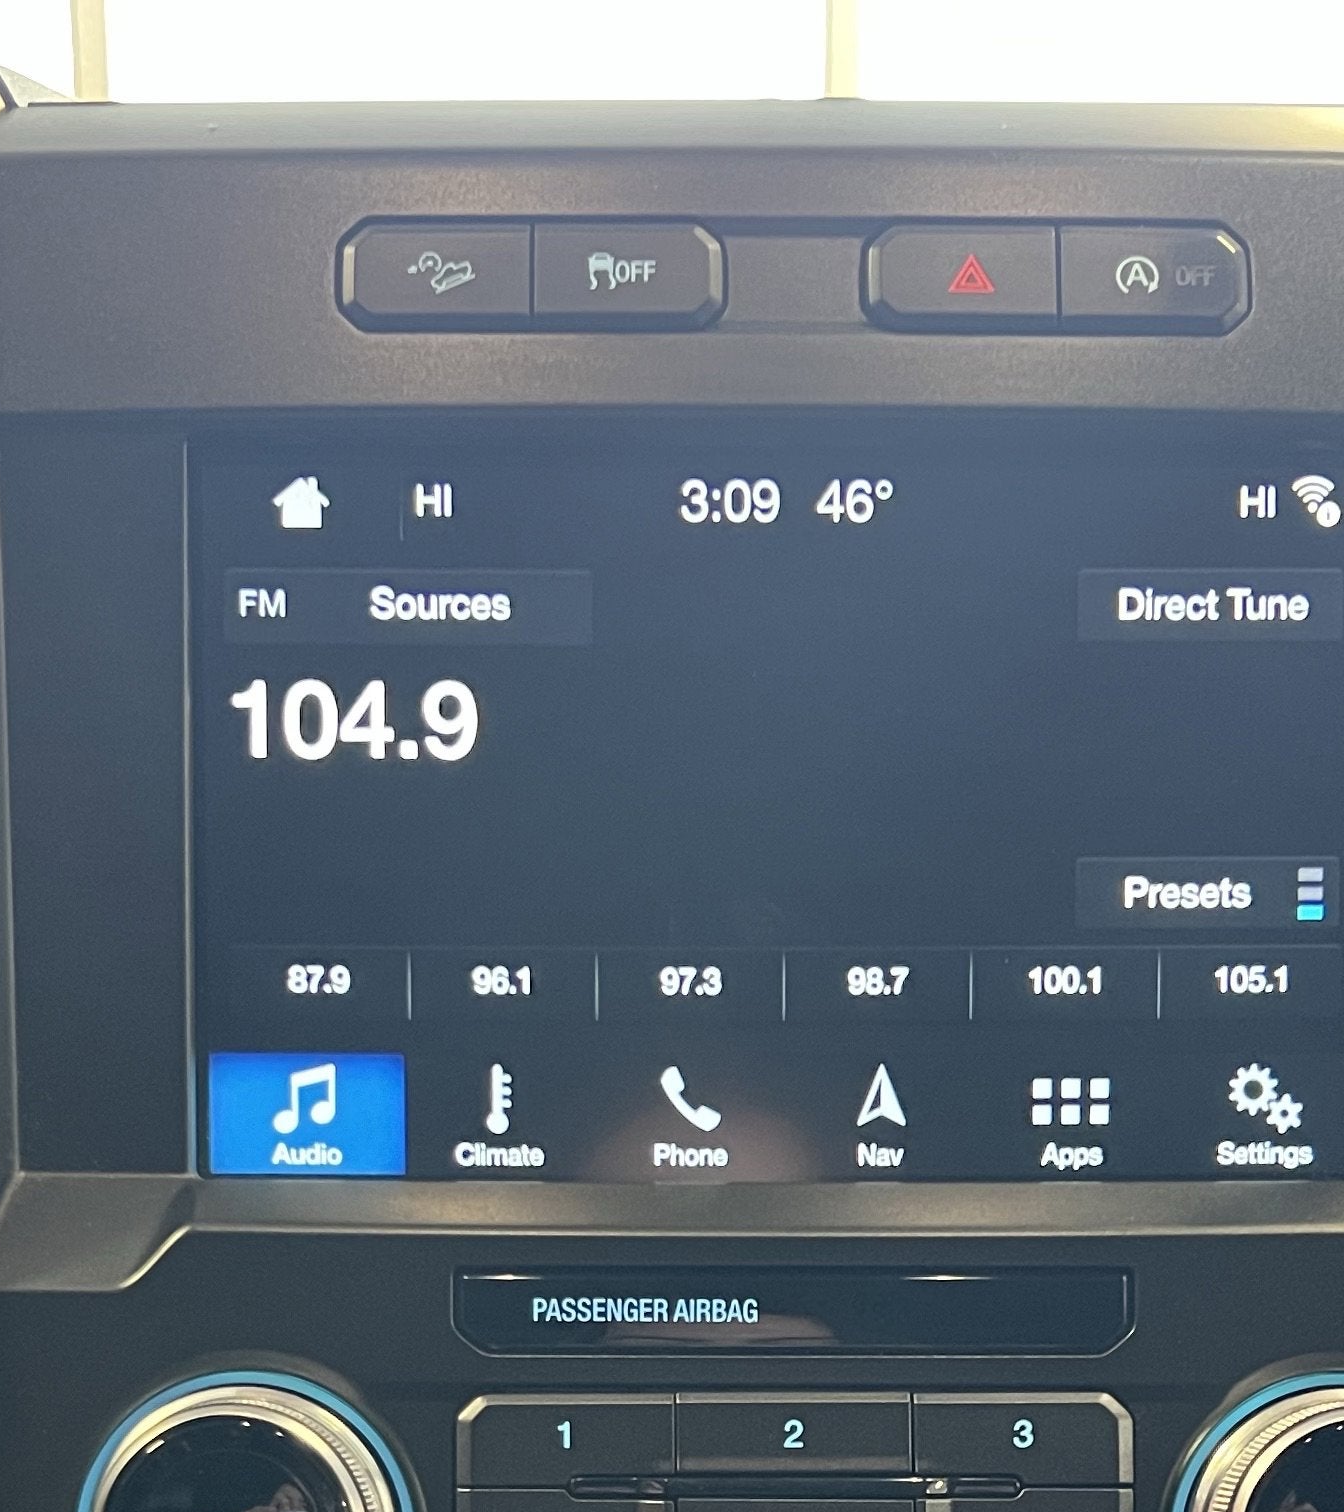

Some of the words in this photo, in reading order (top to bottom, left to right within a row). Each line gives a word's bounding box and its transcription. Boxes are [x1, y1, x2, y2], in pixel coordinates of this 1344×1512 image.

[615, 259, 656, 283] OFF
[1175, 265, 1216, 287] OFF
[415, 482, 453, 518] HI
[680, 477, 781, 524] 3:09
[816, 478, 894, 524] 46°
[1239, 484, 1277, 519] HI
[238, 587, 286, 618] FM
[369, 584, 511, 621] Sources
[1118, 586, 1220, 622] Direct
[1225, 586, 1310, 621] Tune
[230, 678, 479, 762] 104.9
[1124, 875, 1252, 910] Presets
[286, 963, 351, 995] 87.9
[471, 965, 531, 996] 96.1
[659, 965, 723, 997] 97.3
[847, 965, 910, 996] 98.7
[1028, 965, 1102, 995] 100.1
[1214, 964, 1288, 994] 105.1
[272, 1142, 343, 1167] Audio
[454, 1141, 545, 1167] Climate
[653, 1142, 729, 1168] Phone
[857, 1142, 905, 1167] Nav
[1040, 1141, 1104, 1171] Apps
[1216, 1140, 1314, 1170] Settings
[532, 1296, 669, 1323] PASSENGER
[672, 1298, 759, 1324] AIRBAG
[557, 1420, 571, 1449] 1
[783, 1419, 804, 1449] 2
[1012, 1419, 1034, 1449] 3
